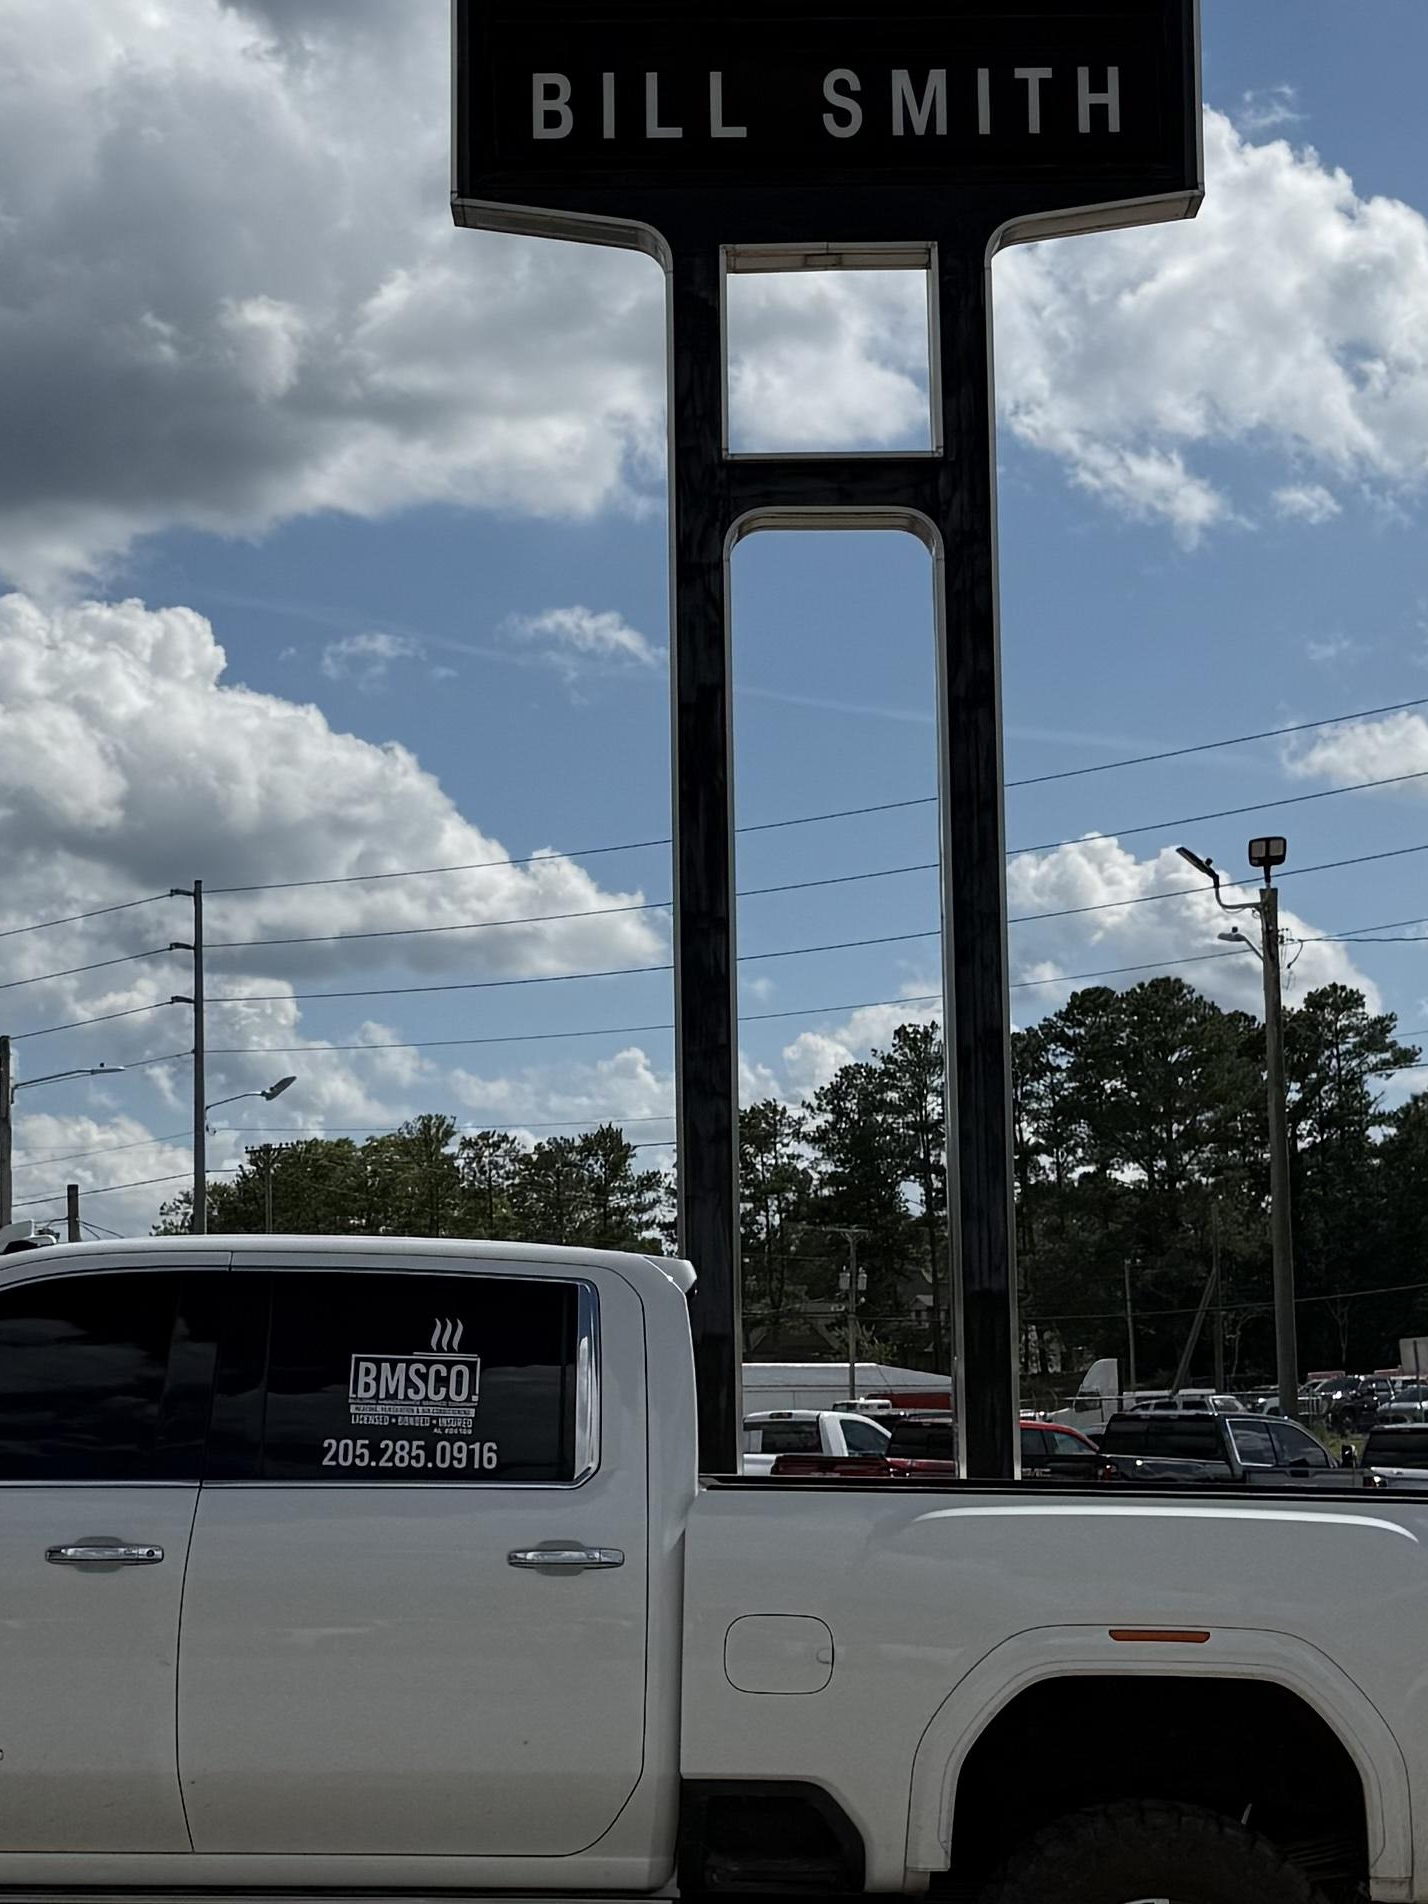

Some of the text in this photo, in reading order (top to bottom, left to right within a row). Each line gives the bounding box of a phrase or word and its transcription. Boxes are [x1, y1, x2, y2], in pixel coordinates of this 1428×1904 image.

[531, 66, 1121, 140] BILL SMITH
[321, 1438, 498, 1470] 205.285.0916
